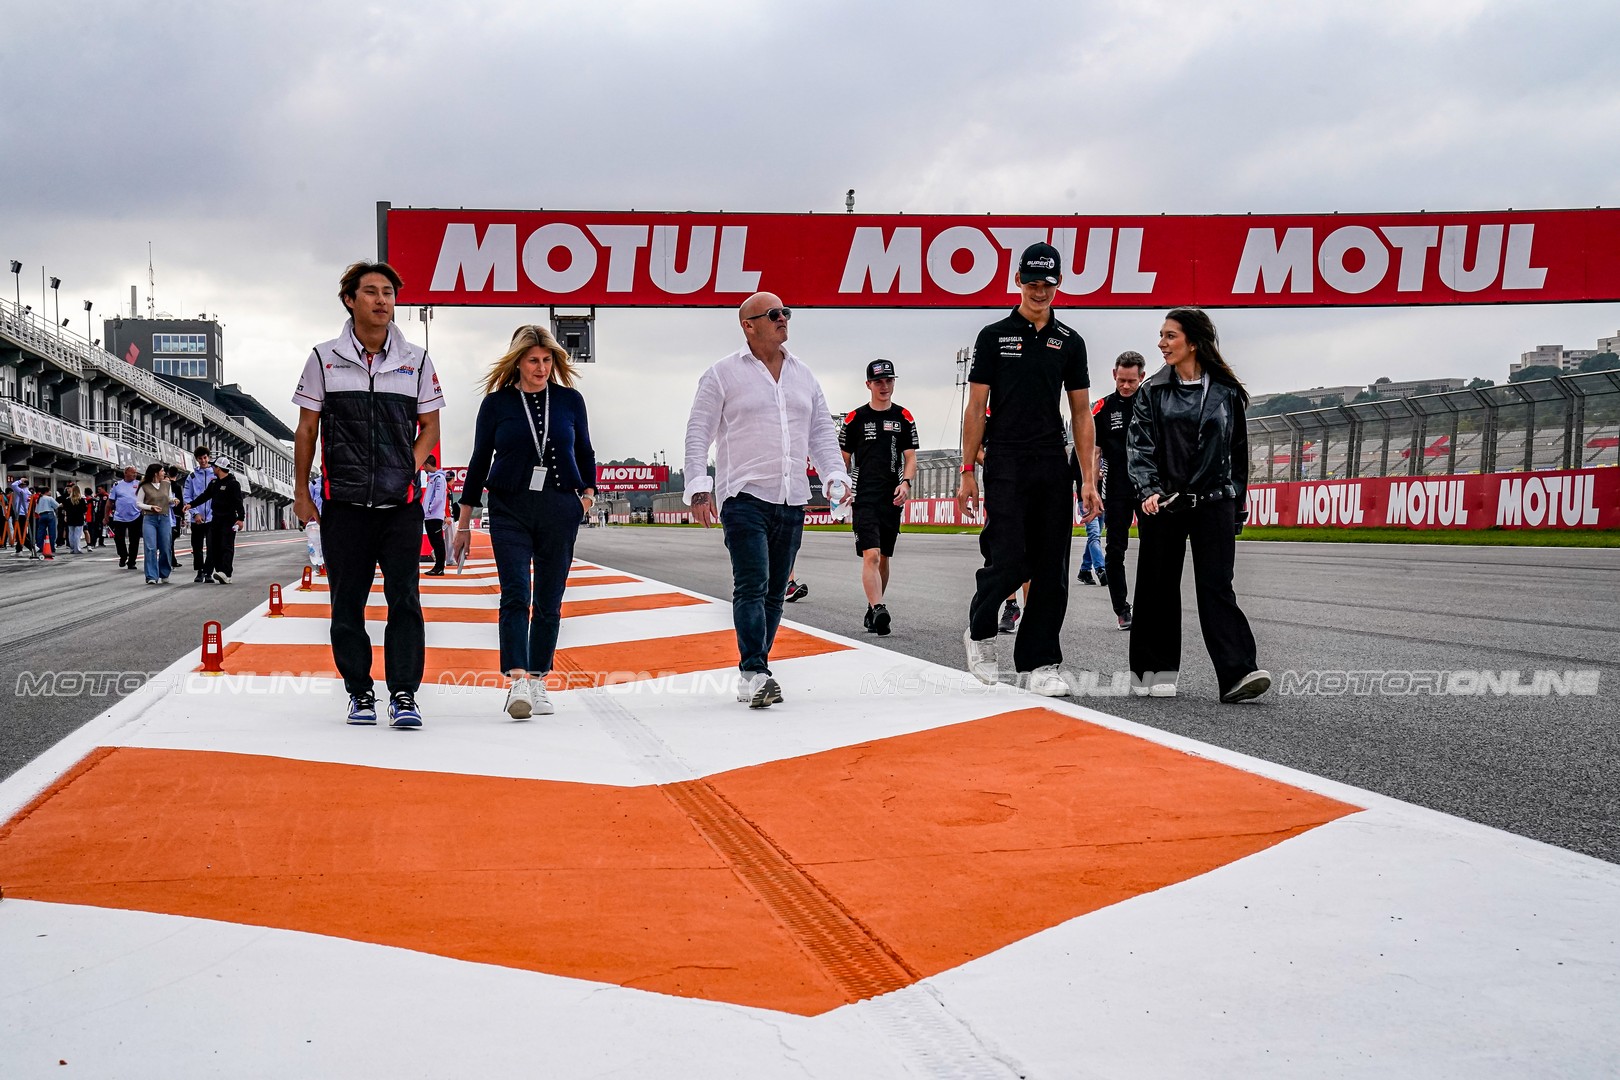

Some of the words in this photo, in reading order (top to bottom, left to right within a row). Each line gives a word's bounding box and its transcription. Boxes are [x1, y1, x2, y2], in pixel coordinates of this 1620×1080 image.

[430, 223, 762, 295] MOTUL
[838, 226, 1157, 295] MOTUL
[1231, 223, 1548, 295] MOTUL
[601, 468, 654, 480] MOTUL
[910, 501, 928, 524] MOTUL
[934, 501, 954, 524] MOTUL
[1243, 488, 1279, 526] TUL
[1297, 483, 1364, 526] MOTUL
[1385, 480, 1468, 526] MOTUL
[1496, 474, 1600, 527] MOTUL
[804, 514, 833, 525] OTUL
